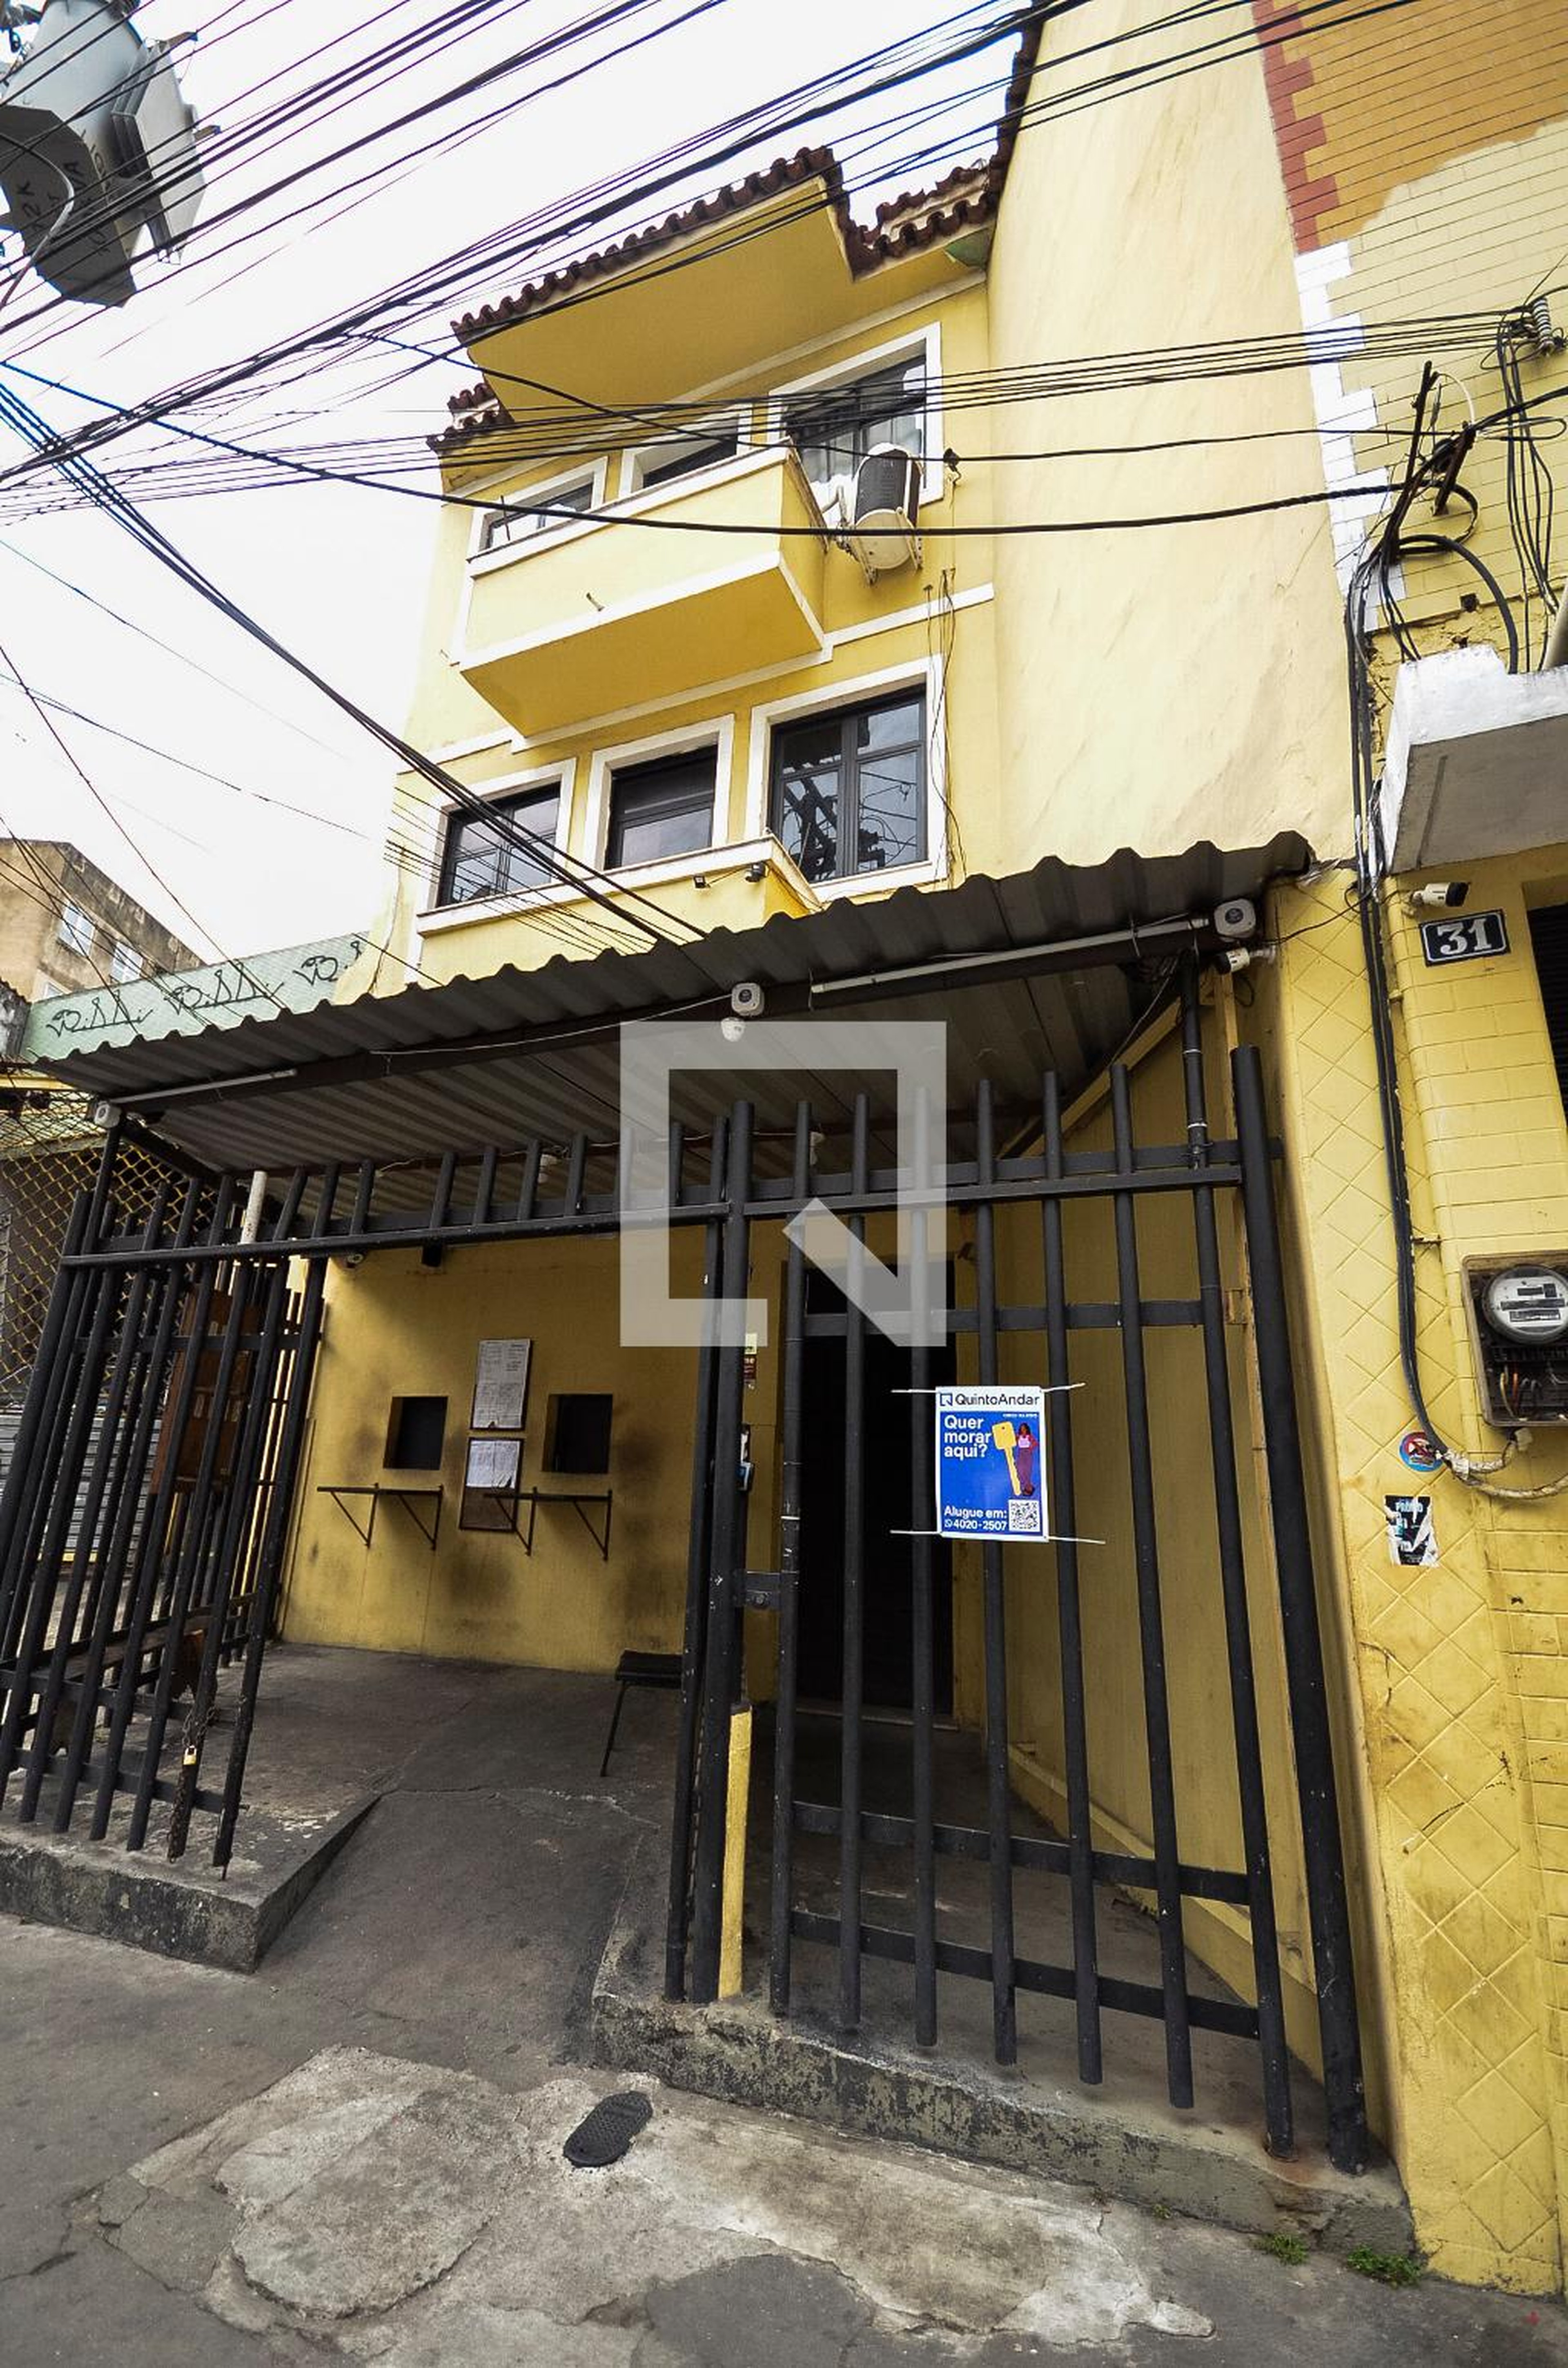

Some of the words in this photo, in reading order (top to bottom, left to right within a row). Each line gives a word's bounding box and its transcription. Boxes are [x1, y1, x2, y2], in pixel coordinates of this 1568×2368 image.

[1437, 919, 1492, 955] 31
[955, 1393, 1040, 1405] QuintoAndar
[944, 1415, 984, 1429] Quer
[944, 1432, 991, 1443] morar
[944, 1444, 988, 1460] aqui?
[944, 1505, 983, 1519] Alugue
[985, 1510, 1007, 1518] em:
[953, 1519, 1007, 1531] 4020-2507
